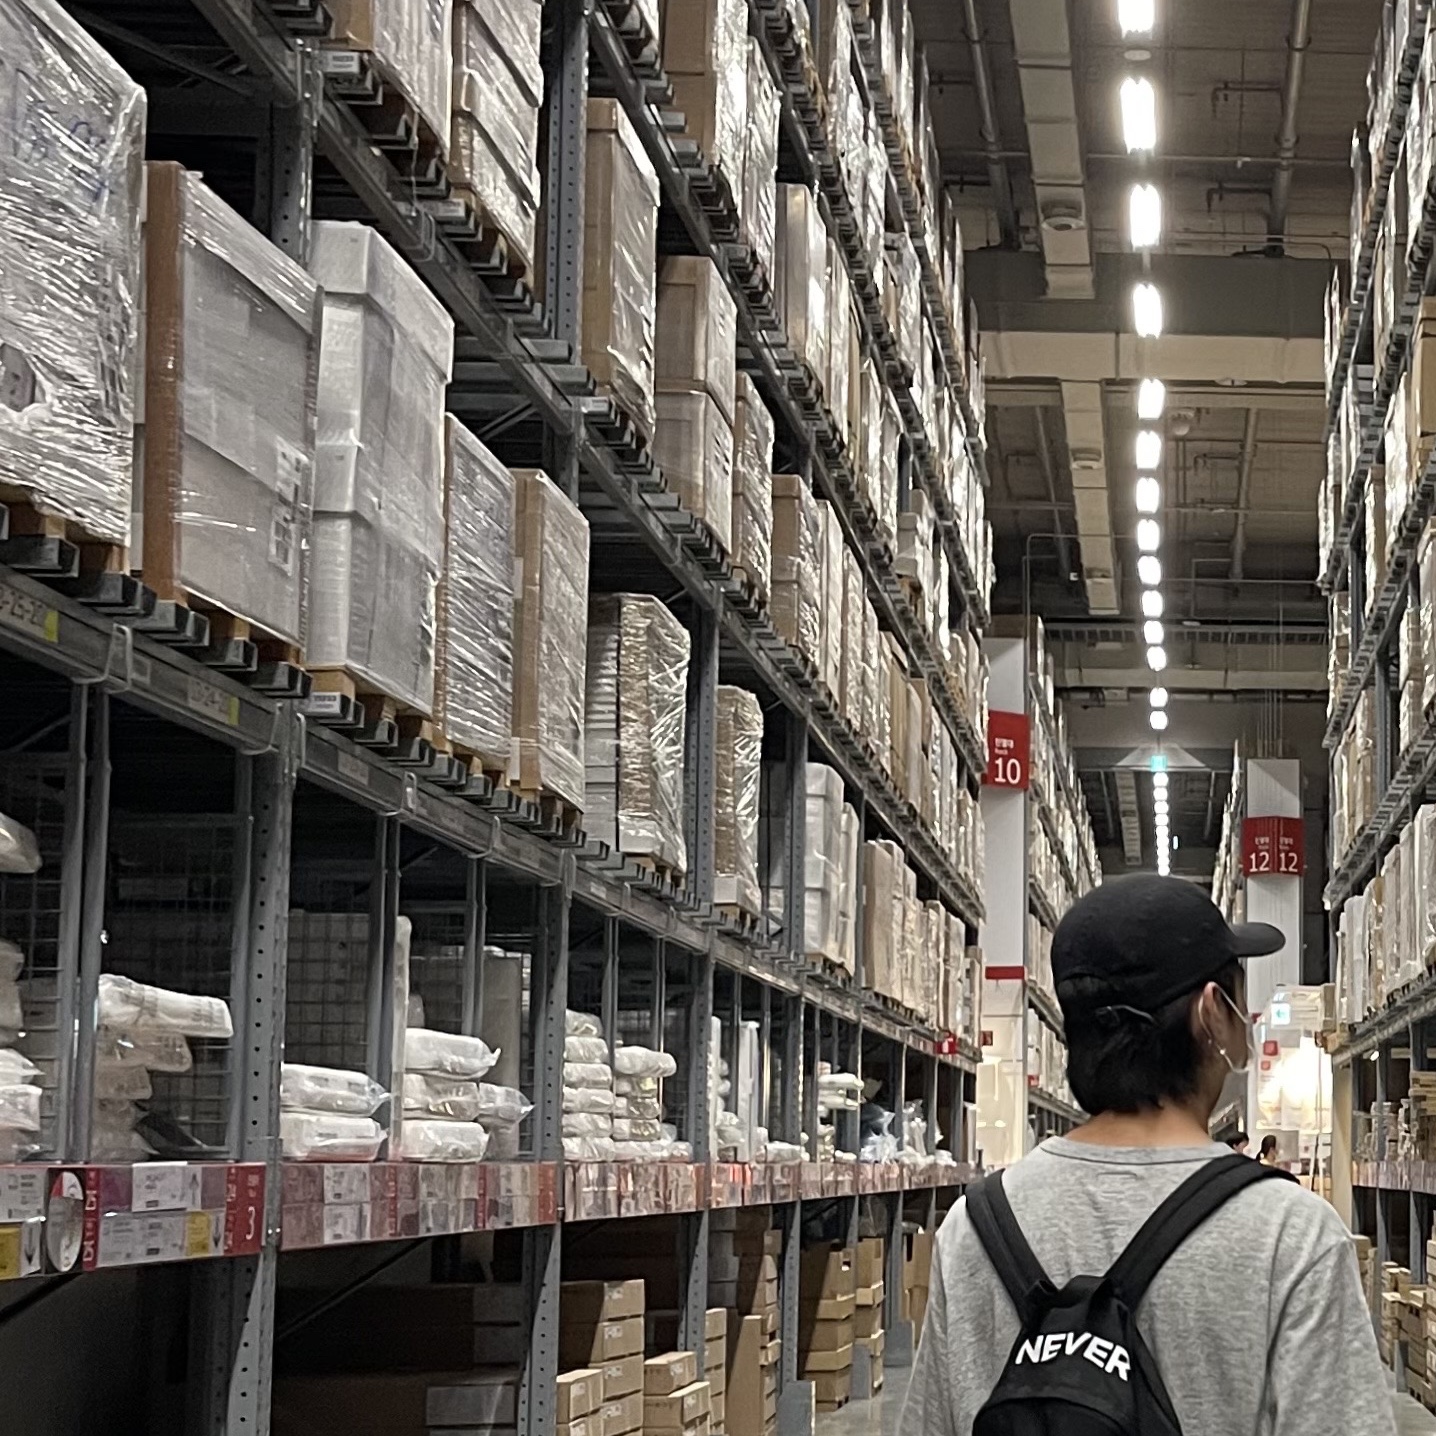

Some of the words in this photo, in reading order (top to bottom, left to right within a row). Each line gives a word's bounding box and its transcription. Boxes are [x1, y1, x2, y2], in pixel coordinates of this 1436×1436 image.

[994, 757, 1021, 785] 10
[1249, 851, 1270, 873] 12
[1280, 852, 1298, 873] 12
[245, 1206, 256, 1241] 3
[1015, 1331, 1131, 1381] NEVER
